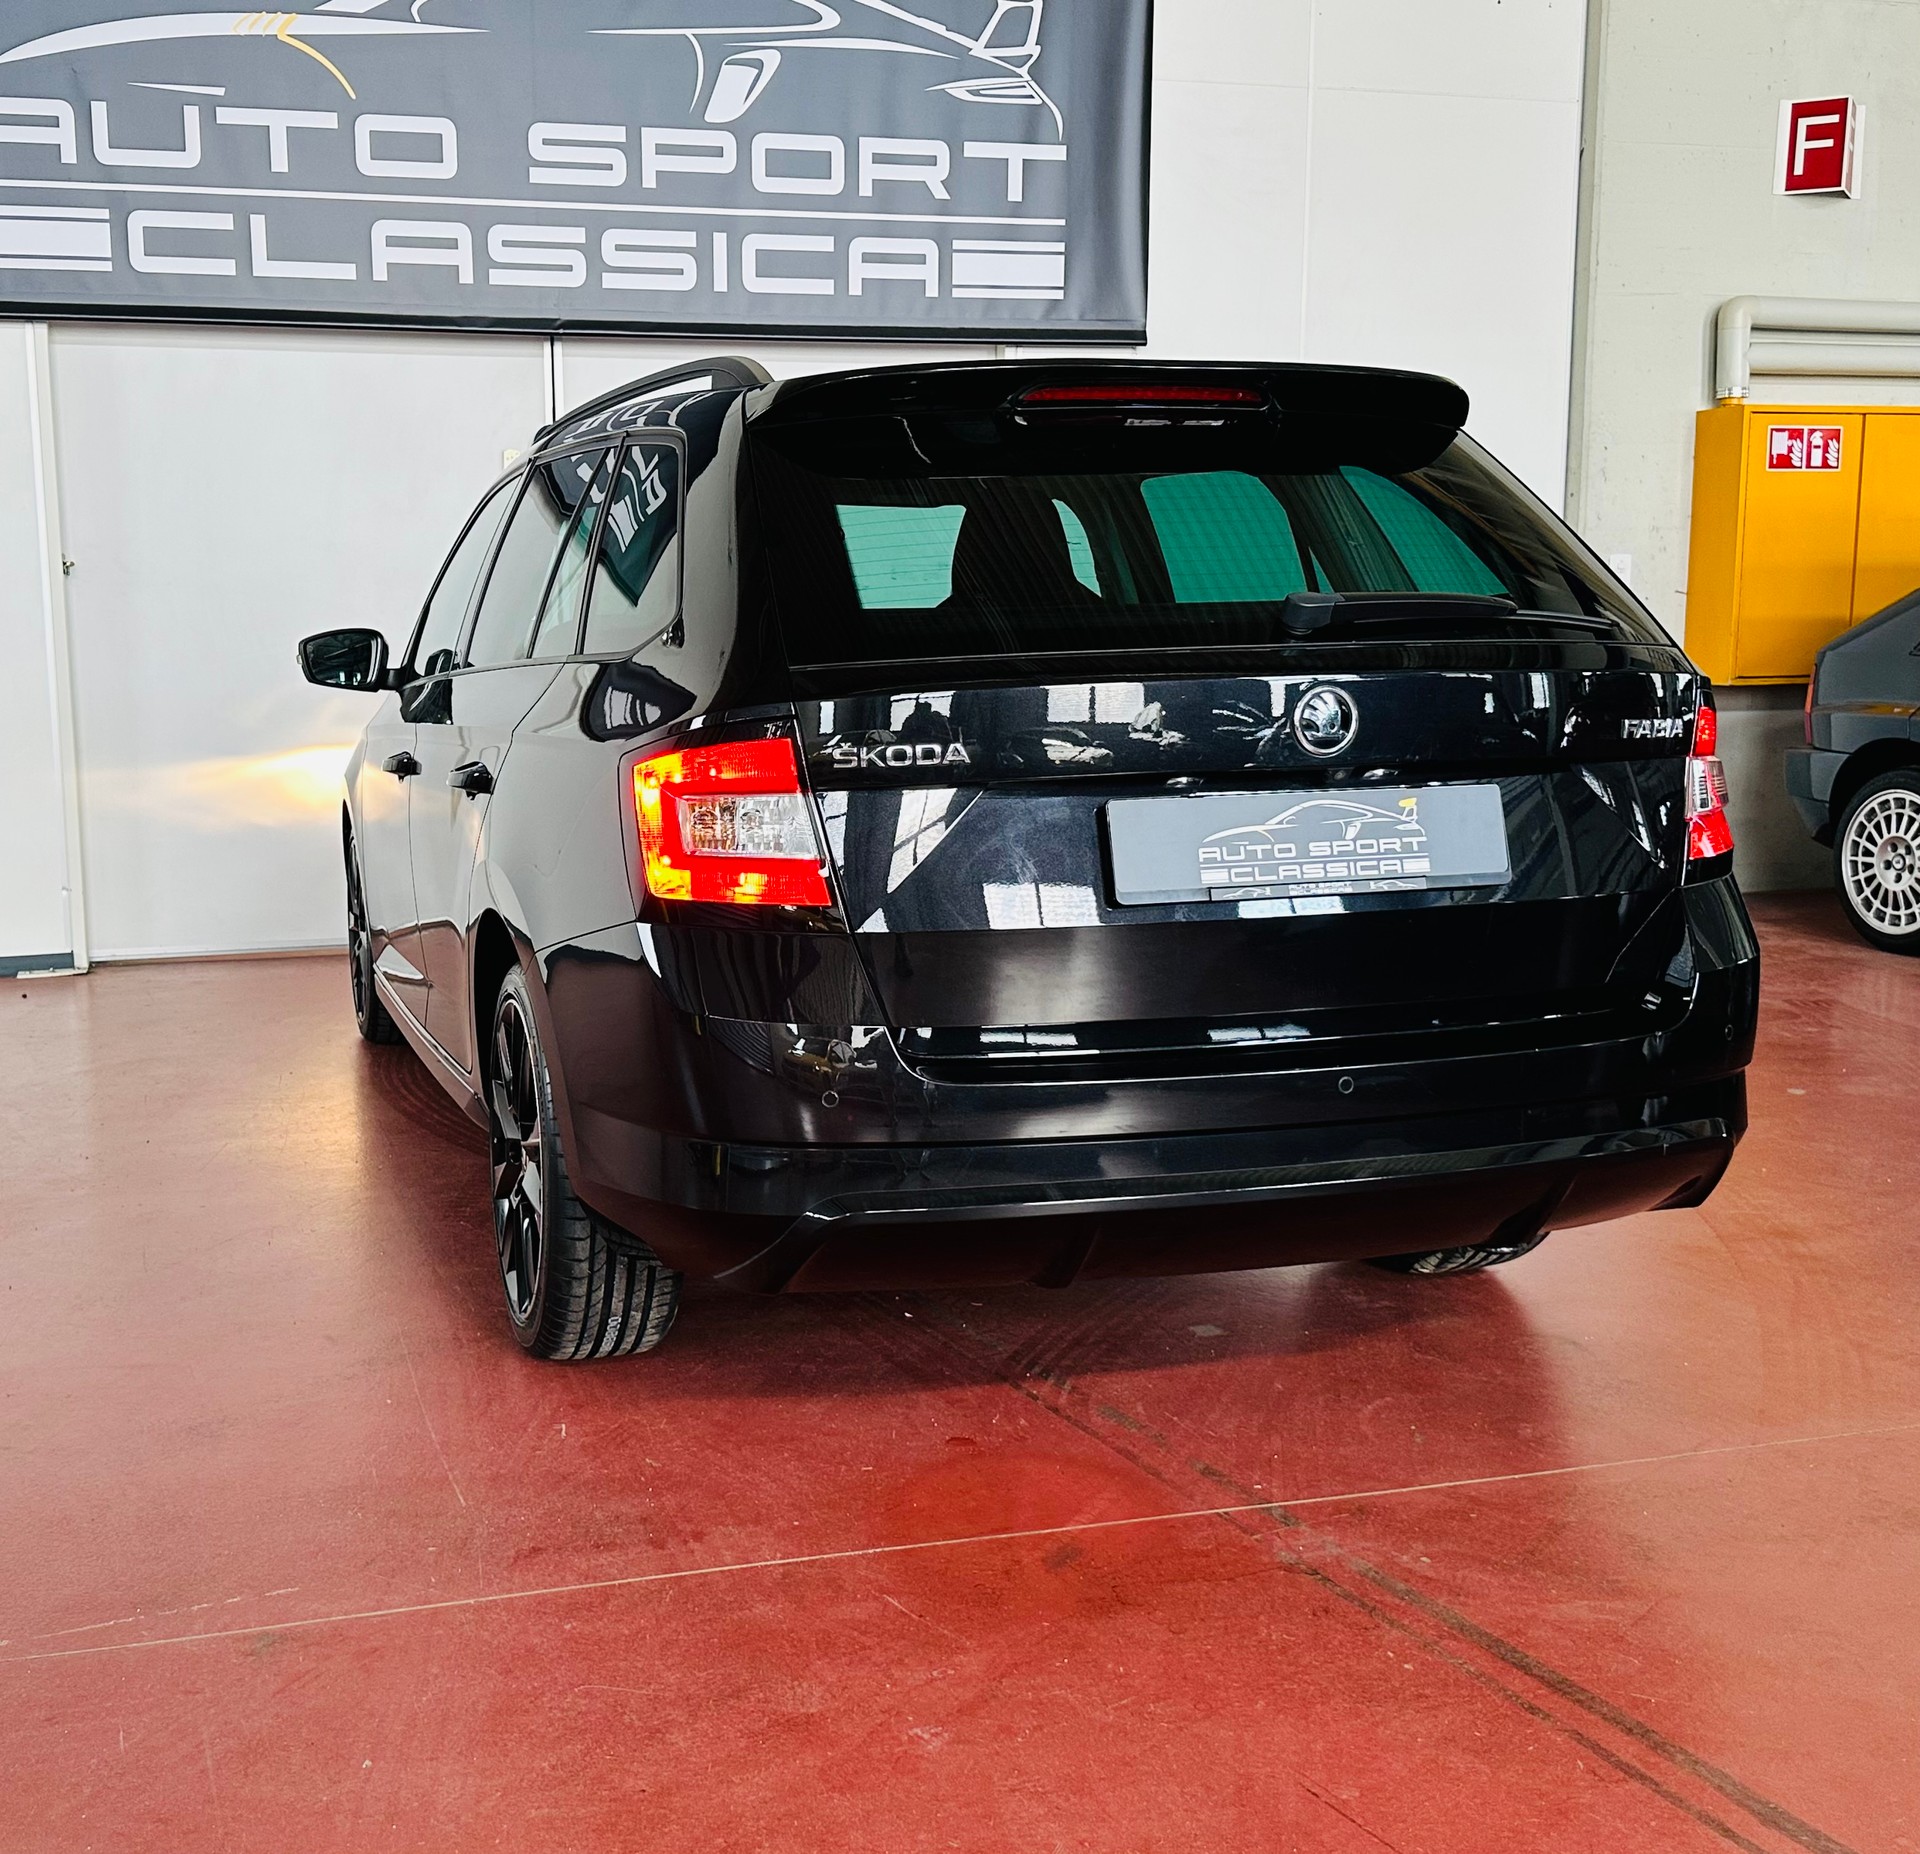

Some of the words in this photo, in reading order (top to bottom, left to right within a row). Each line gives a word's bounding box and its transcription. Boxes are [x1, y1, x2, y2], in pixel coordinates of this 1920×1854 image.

[0, 97, 458, 180] AUTO
[528, 122, 1067, 202] SPORT
[1793, 113, 1840, 176] F
[127, 209, 940, 298] CLASSICA
[1622, 717, 1684, 738] FABIA
[833, 742, 971, 769] ŠKODA
[1199, 843, 1297, 862] AUTO
[1309, 836, 1428, 857] SPORT
[1230, 859, 1403, 883] CLASSICA
